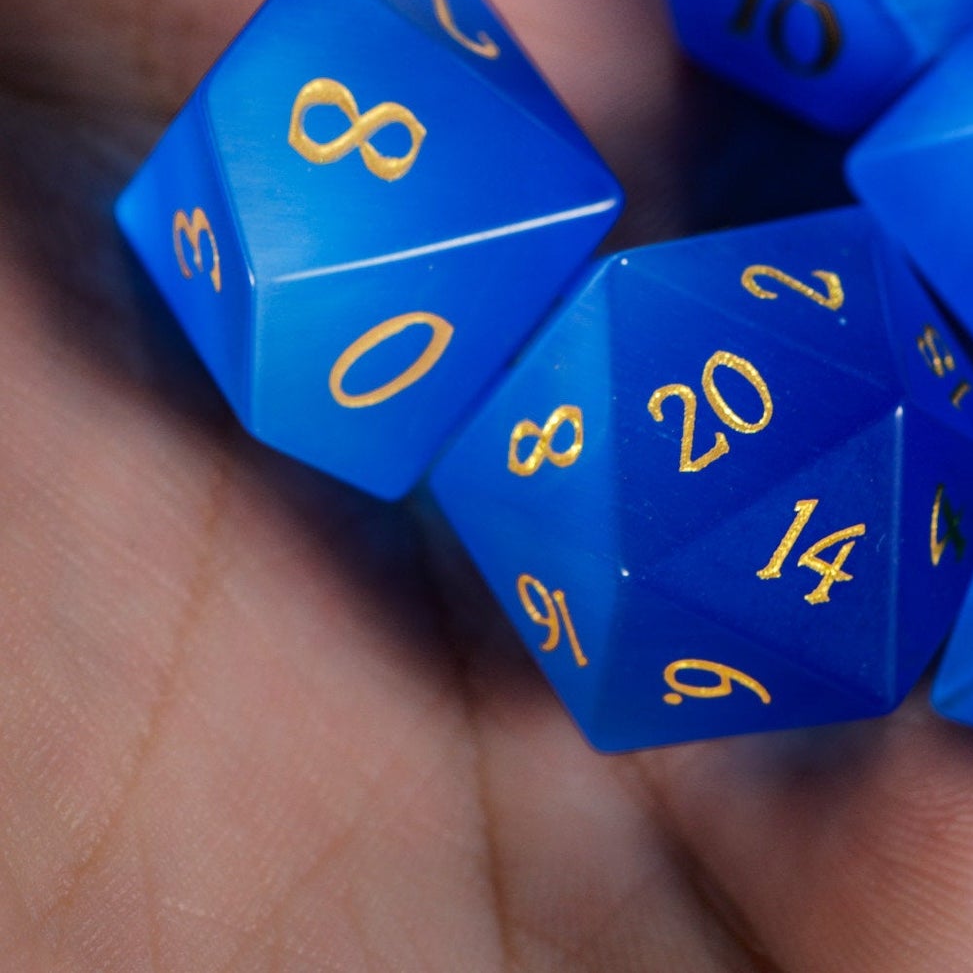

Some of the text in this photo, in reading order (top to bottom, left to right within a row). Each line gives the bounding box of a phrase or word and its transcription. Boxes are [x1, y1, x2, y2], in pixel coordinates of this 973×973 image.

[287, 76, 427, 183] 8
[172, 206, 222, 293] 3
[740, 263, 845, 312] 2
[327, 310, 455, 409] 0
[507, 403, 585, 477] 8
[647, 349, 774, 473] 20
[755, 498, 867, 605] 14
[928, 482, 970, 568] 4
[515, 572, 589, 668] 16
